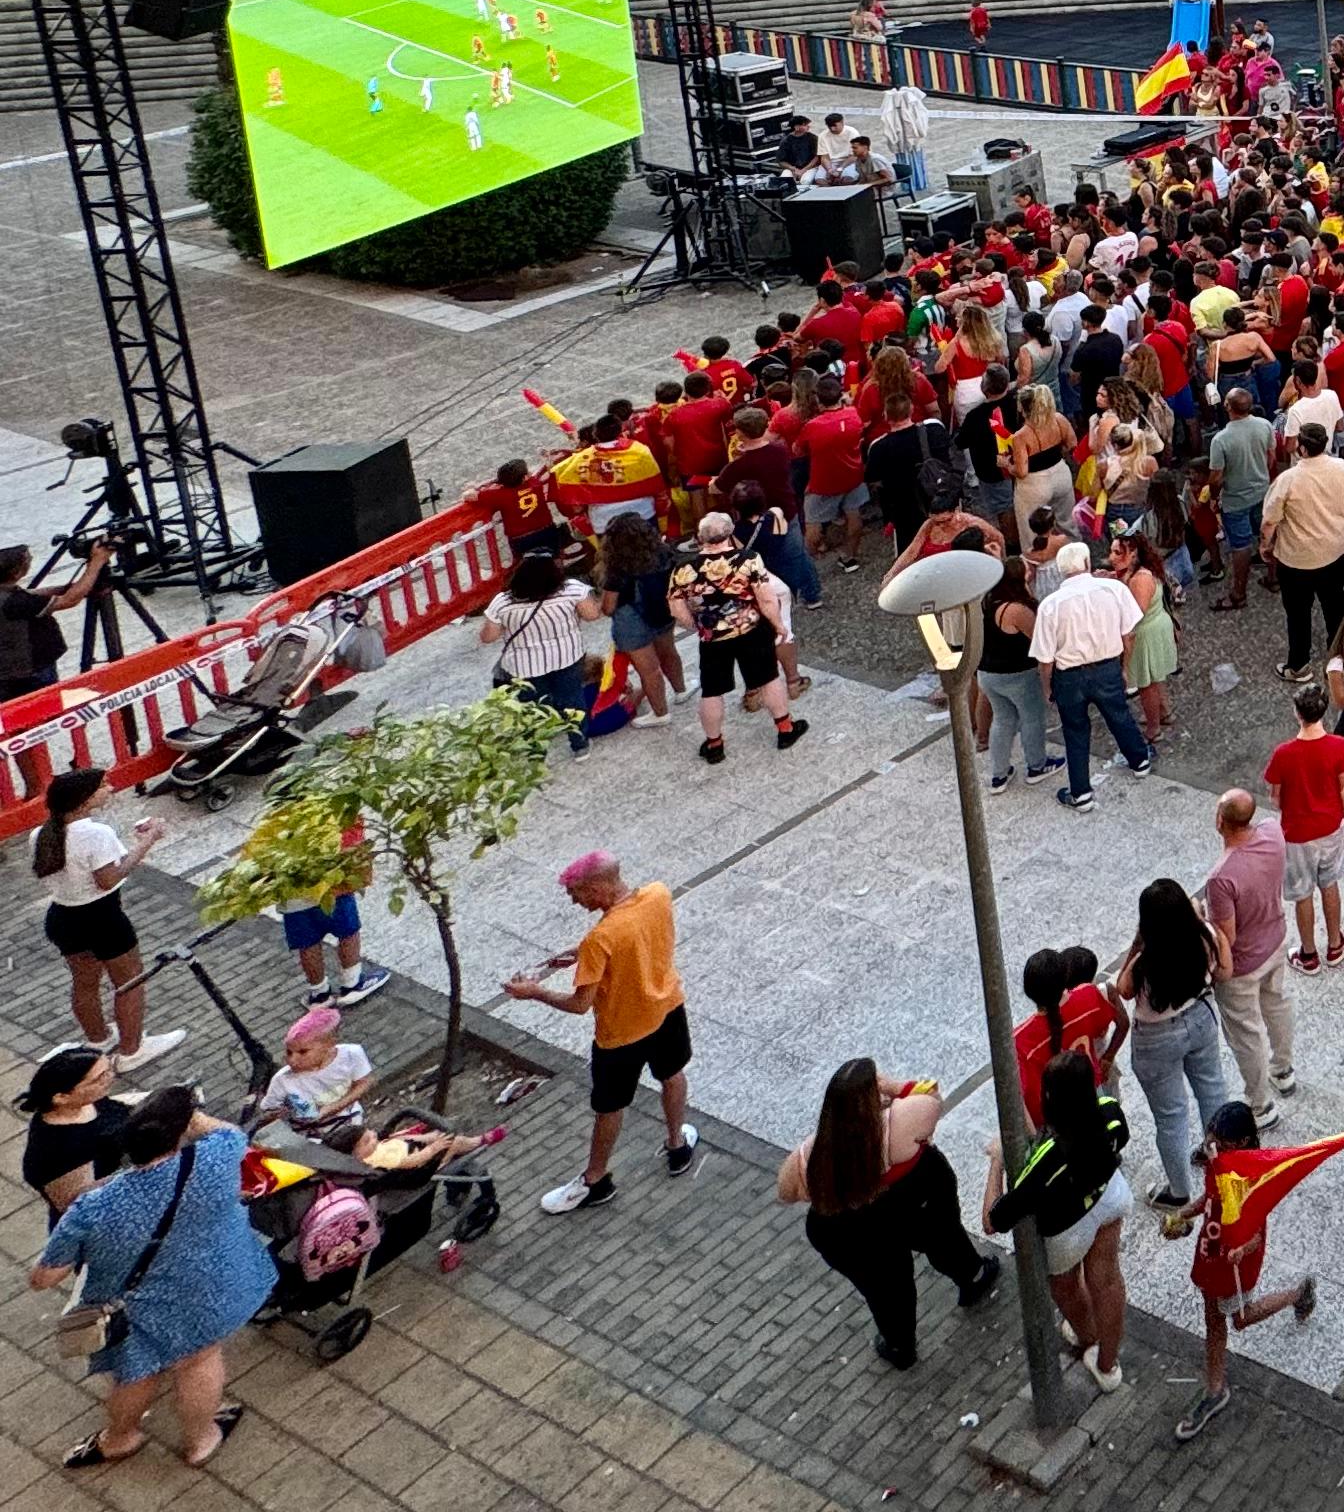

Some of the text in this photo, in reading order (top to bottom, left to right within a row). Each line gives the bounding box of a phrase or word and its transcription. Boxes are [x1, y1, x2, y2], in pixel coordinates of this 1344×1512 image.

[722, 377, 738, 401] 9
[518, 492, 538, 518] 9
[99, 671, 178, 713] POLICIA LOCAL
